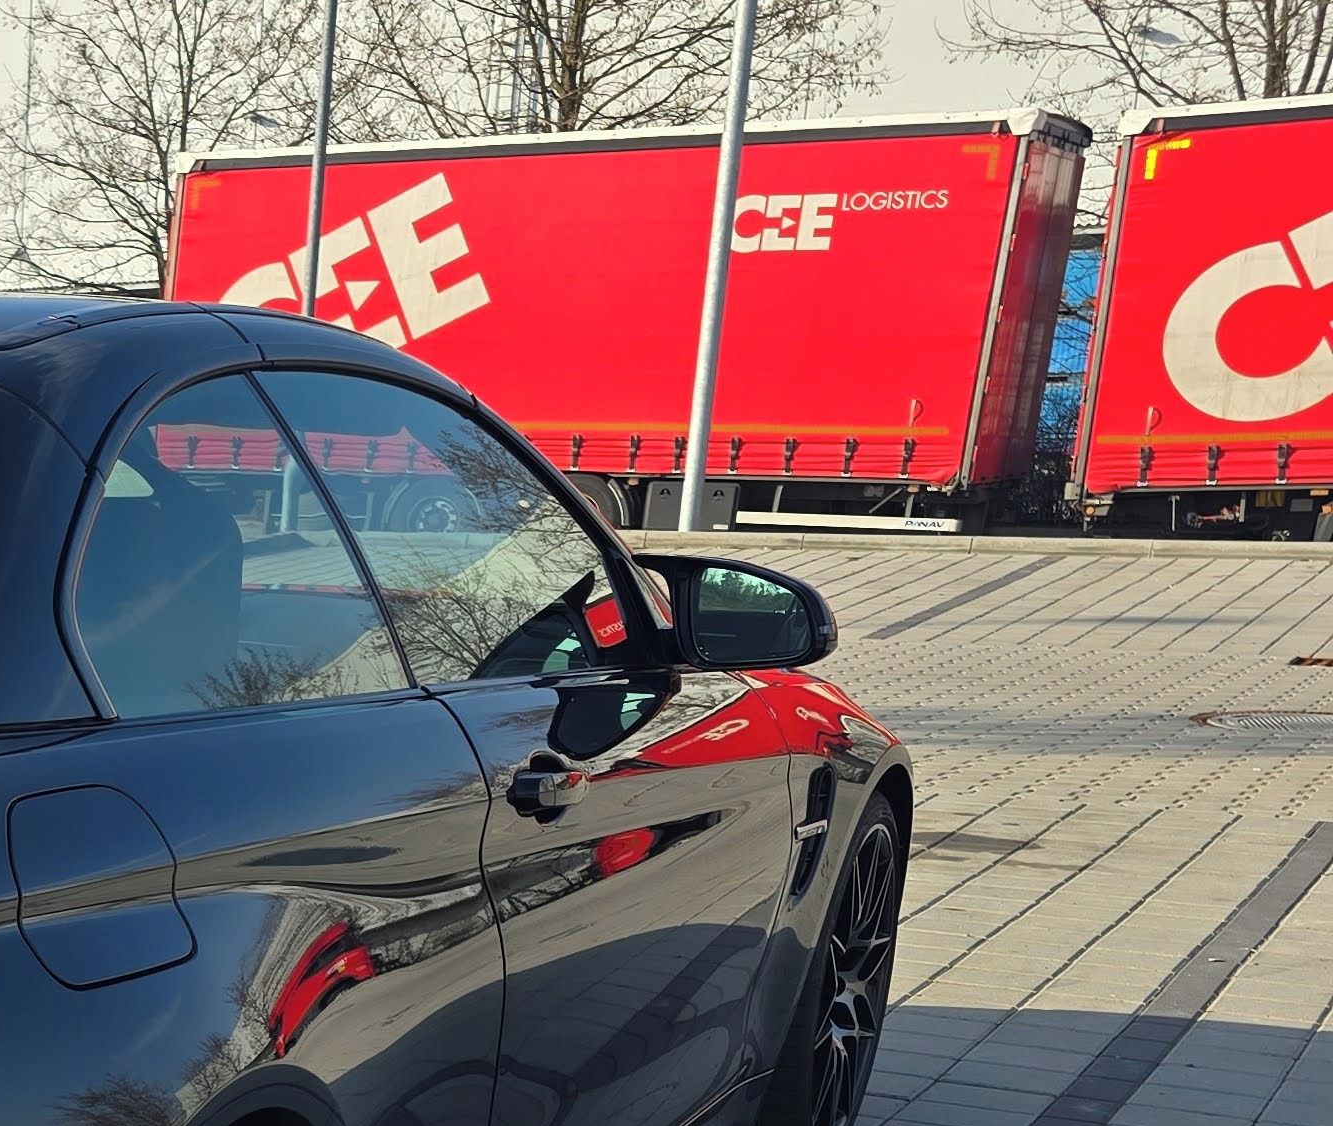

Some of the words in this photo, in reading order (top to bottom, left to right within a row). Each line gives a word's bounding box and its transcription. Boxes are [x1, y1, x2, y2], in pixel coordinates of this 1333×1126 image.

[730, 194, 838, 253] CEE
[841, 190, 949, 211] LOGISTICS
[1162, 210, 1333, 422] C
